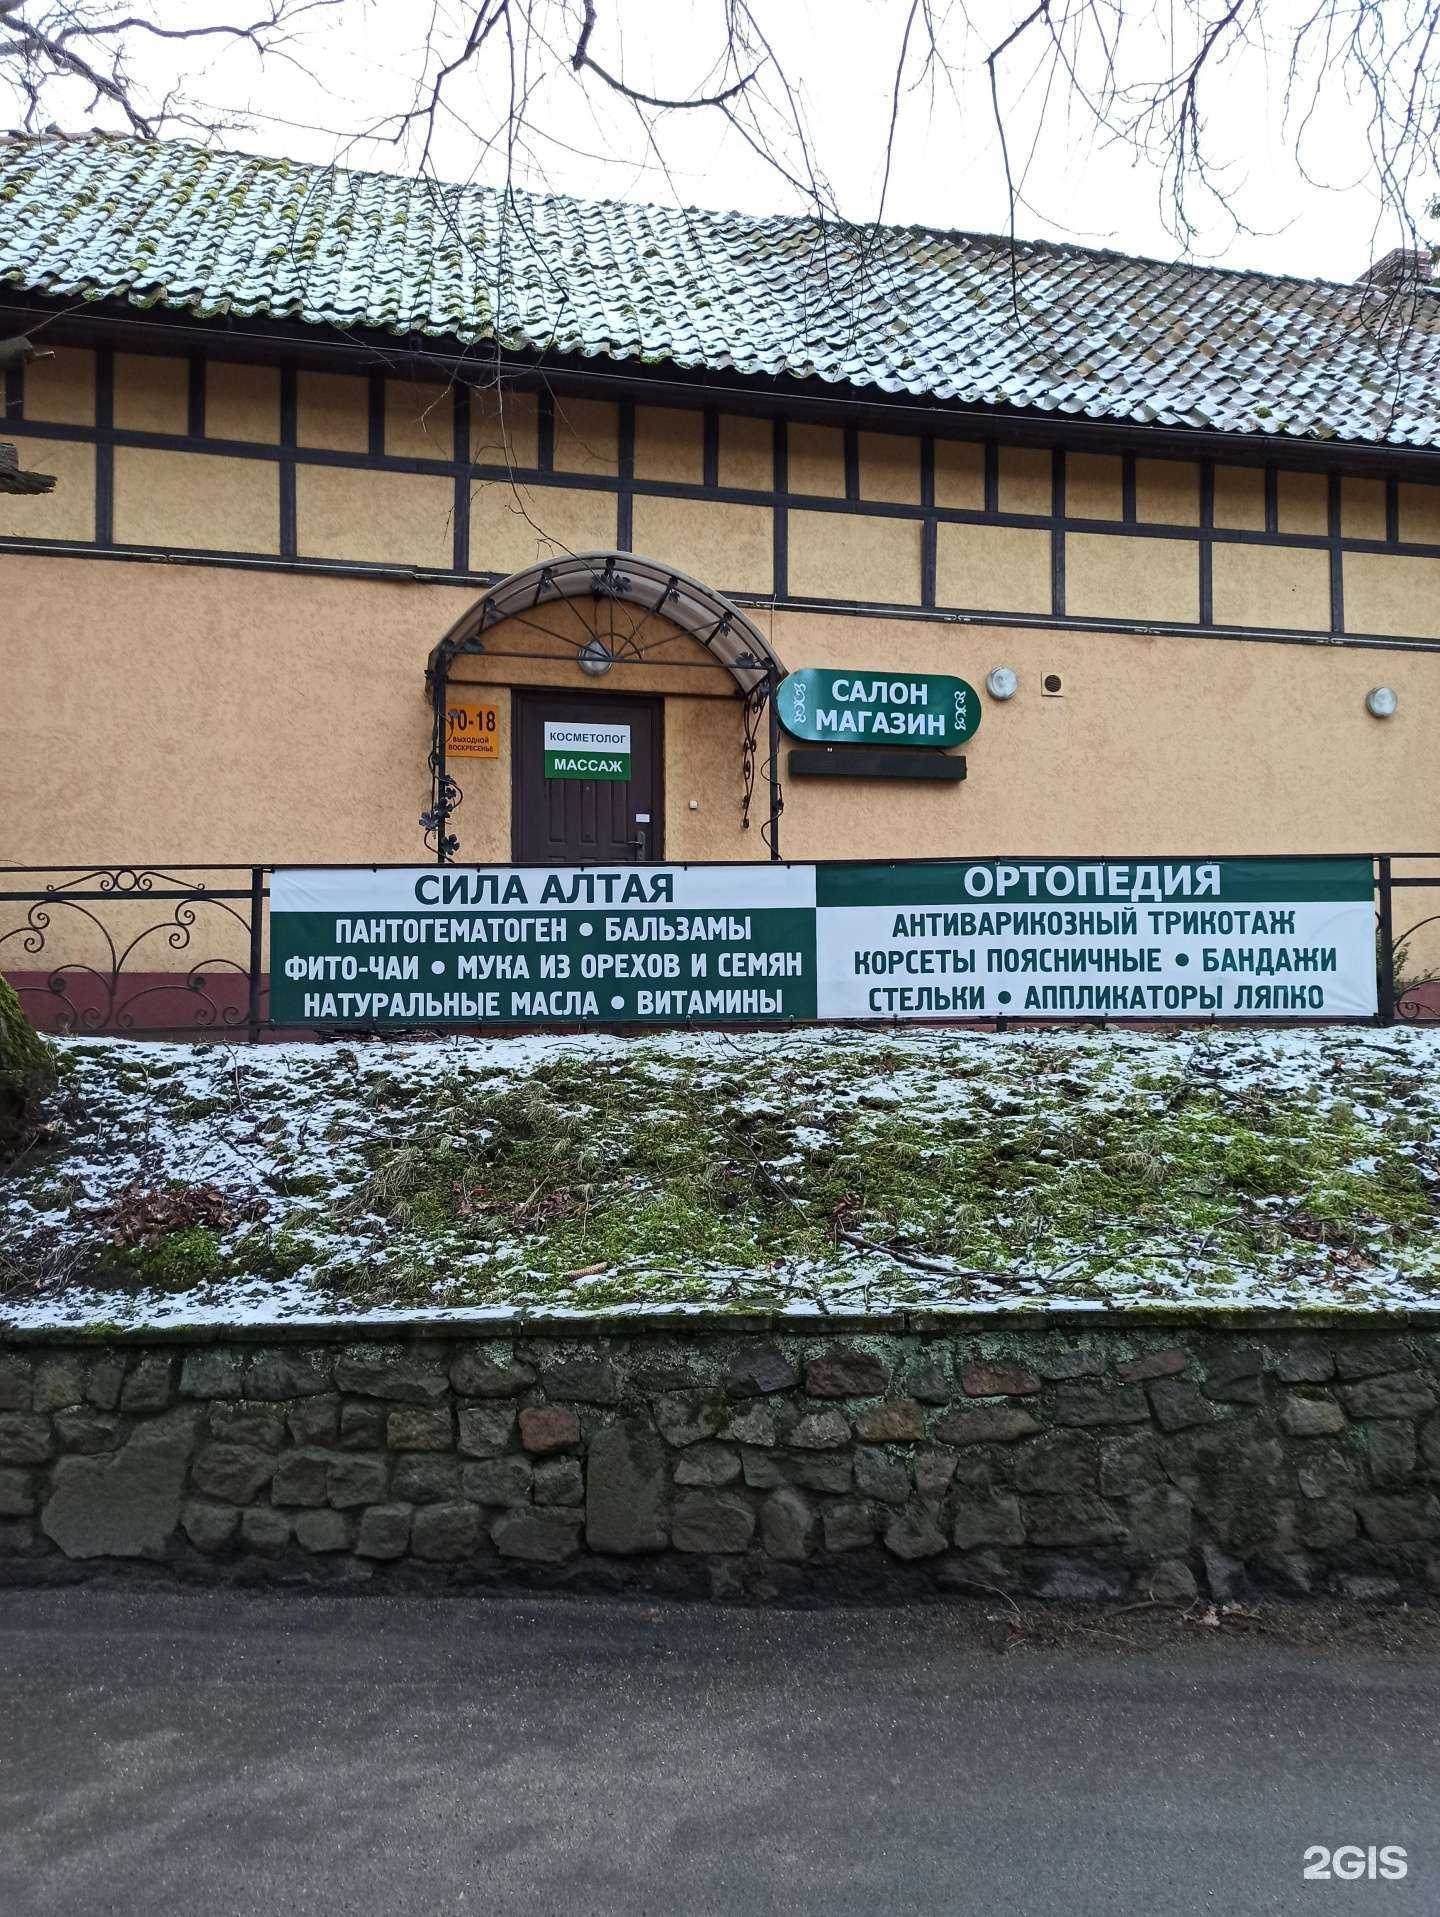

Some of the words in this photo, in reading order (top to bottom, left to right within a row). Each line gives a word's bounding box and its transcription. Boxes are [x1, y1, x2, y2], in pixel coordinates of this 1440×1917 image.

[832, 679, 927, 705] САЛОН
[816, 709, 945, 736] МАГАЗИН
[448, 744, 493, 752] ВОСКРЕСЕНЬЕ
[452, 736, 489, 744] ВЫХОДНОЙ
[550, 732, 626, 744] КОСМЕТОЛОГ
[554, 758, 623, 772] МАССАЖ
[414, 874, 529, 906] СИЛА
[539, 873, 674, 905] АЛТАЯ
[963, 864, 1221, 902] ОРТОПЕДИЯ
[335, 918, 567, 944] ПАНТОГЕМАТОГЕН
[605, 916, 752, 942] БАЛЬЗАМЫ
[891, 907, 1138, 938] АНТИВАРИКОЗНЫЙ
[1152, 911, 1296, 935] ТРИКОТАЖ
[284, 954, 420, 982] ФИТО-ЧАИ
[457, 954, 530, 980] МУКА
[539, 954, 572, 979] ИЗ
[581, 952, 681, 979] ОРЕХОВ
[690, 952, 707, 978] И
[717, 952, 802, 977] СЕМЯН
[853, 949, 977, 975] КОРСЕТЫ
[987, 948, 1162, 973] ПОЯСНИЧНЫЕ
[1202, 948, 1337, 974] БАНДАЖИ
[303, 991, 501, 1018] НАТУРАЛЬНЫЕ
[510, 990, 600, 1016] МАСЛА
[637, 989, 783, 1015] ВИТАМИНЫ
[868, 986, 986, 1012] СТЕЛЬКИ
[1024, 985, 1224, 1011] АППЛИКАТОРЫ
[1233, 984, 1324, 1010] ЛЯПКО
